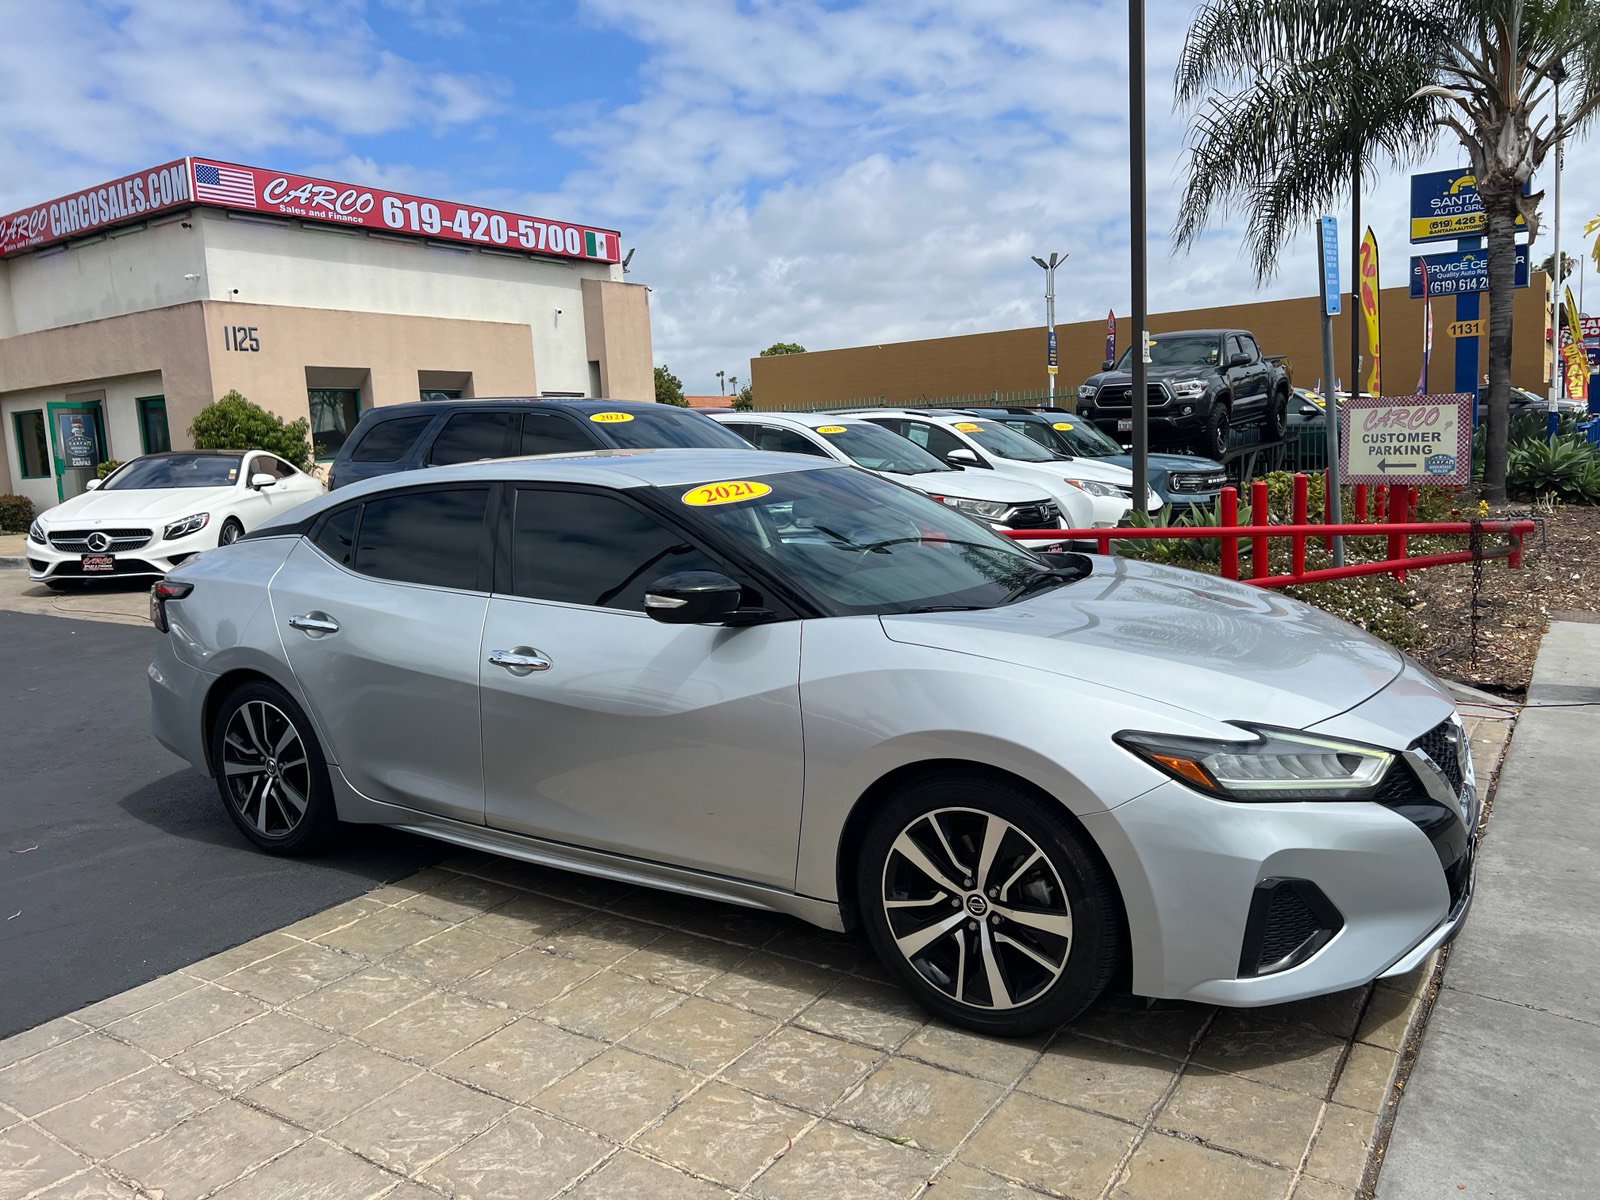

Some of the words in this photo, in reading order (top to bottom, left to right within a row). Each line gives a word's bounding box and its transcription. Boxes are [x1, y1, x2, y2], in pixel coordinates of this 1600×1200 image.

[49, 163, 189, 237] CARCOSALES.COM
[262, 177, 375, 215] CARCO
[1430, 193, 1482, 208] SANTA
[279, 204, 306, 215] Sales
[308, 209, 326, 218] and
[328, 212, 364, 224] Finance
[1434, 205, 1462, 215] AUTO
[381, 196, 581, 255] 619-420-5700
[1429, 219, 1453, 230] (619)
[1455, 216, 1476, 225] 426
[1437, 271, 1460, 279] Quality
[1430, 280, 1456, 294] (619)
[1459, 277, 1477, 290] 614
[1450, 322, 1480, 335] 1131
[224, 325, 260, 352] 1125
[600, 413, 625, 421] 2021
[1362, 406, 1440, 431] CARCO
[1362, 431, 1442, 444] CUSTOMER
[1368, 444, 1433, 456] PARKING
[700, 482, 755, 503] 2021
